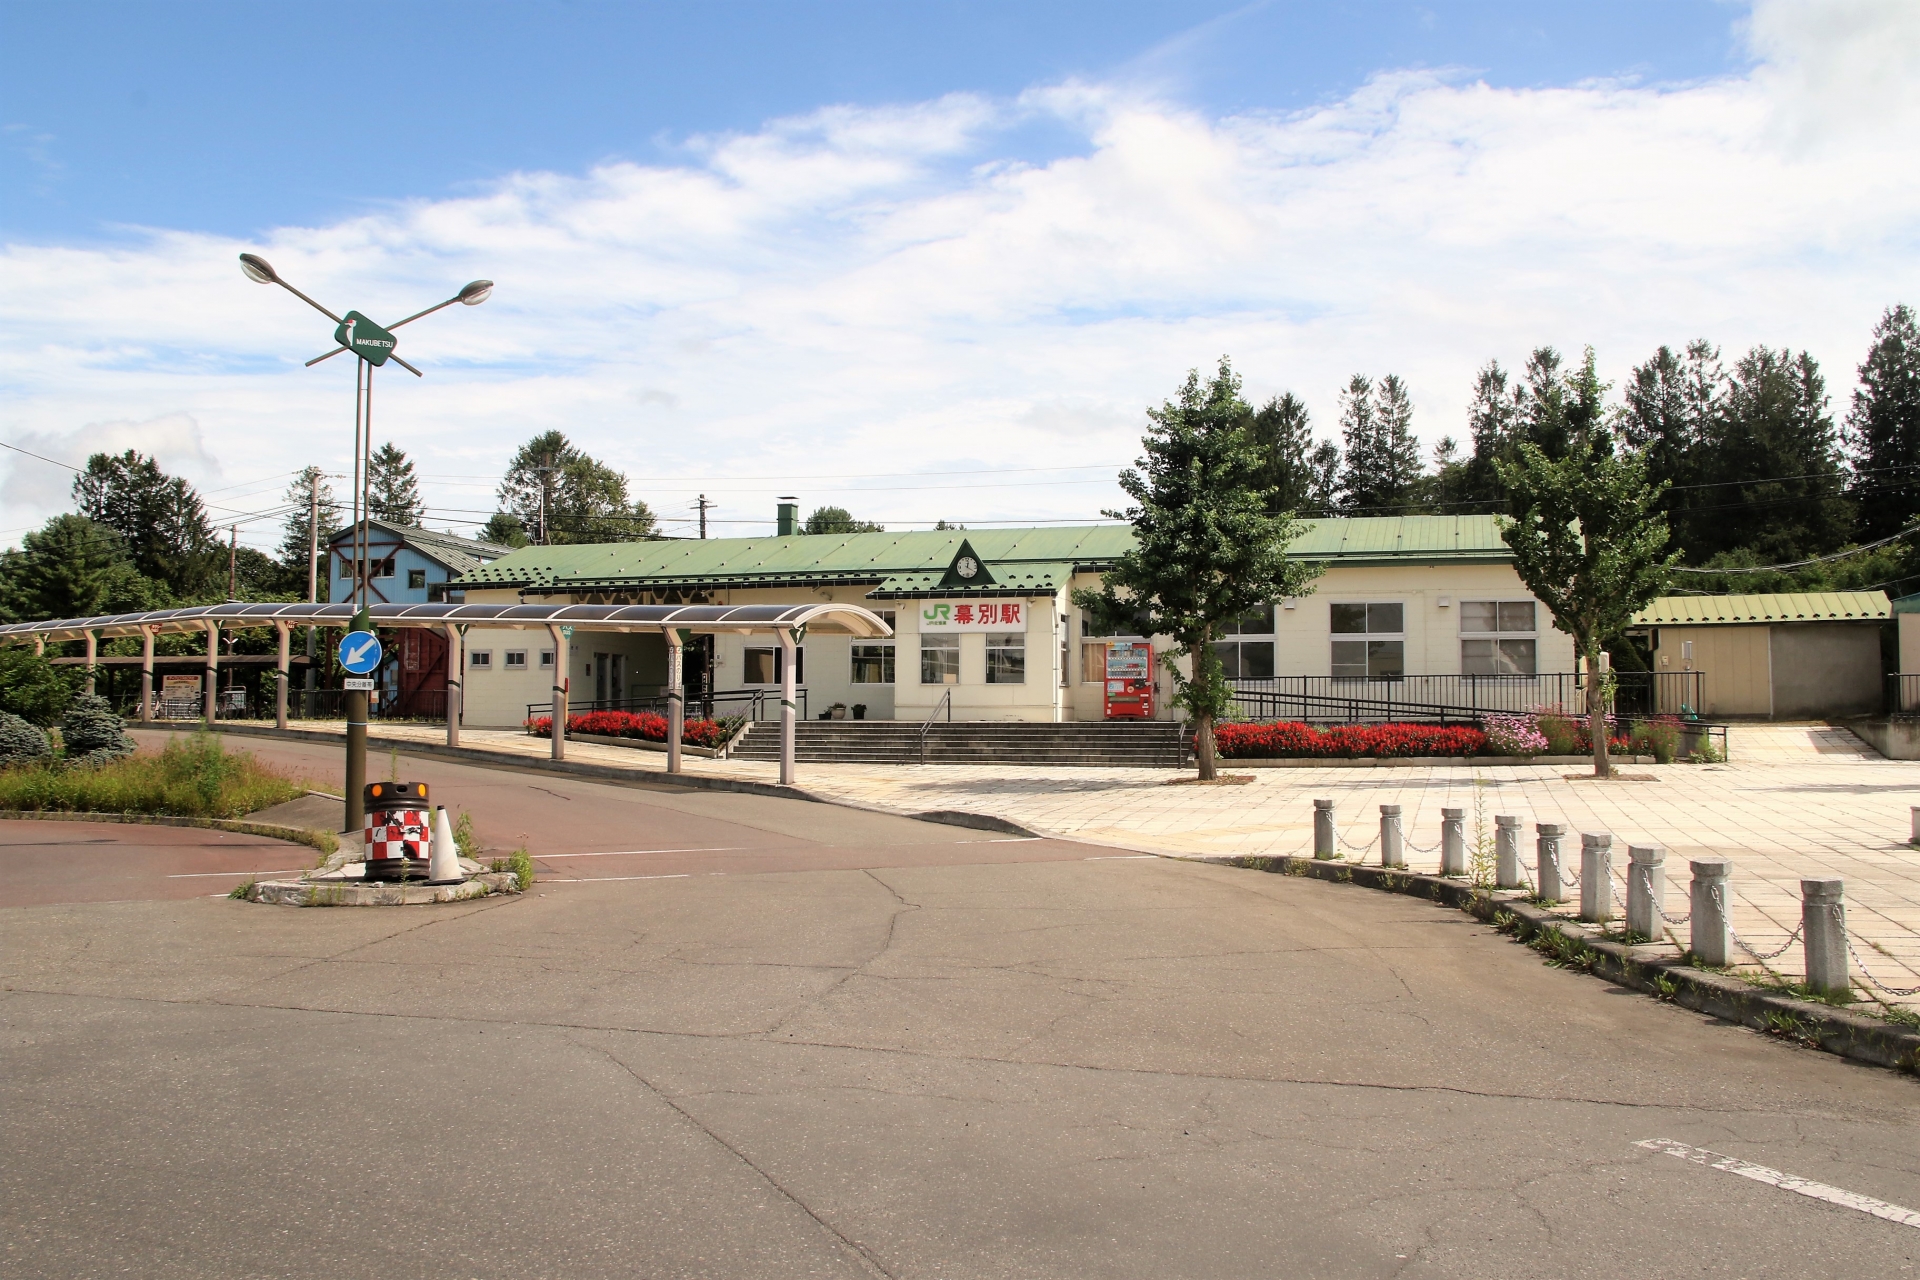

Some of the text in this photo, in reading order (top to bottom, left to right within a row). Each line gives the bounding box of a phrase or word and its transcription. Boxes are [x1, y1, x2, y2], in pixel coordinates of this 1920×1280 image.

[356, 338, 393, 348] MAKUBETSU
[923, 603, 951, 621] JR
[953, 603, 1021, 625] 幕別駅
